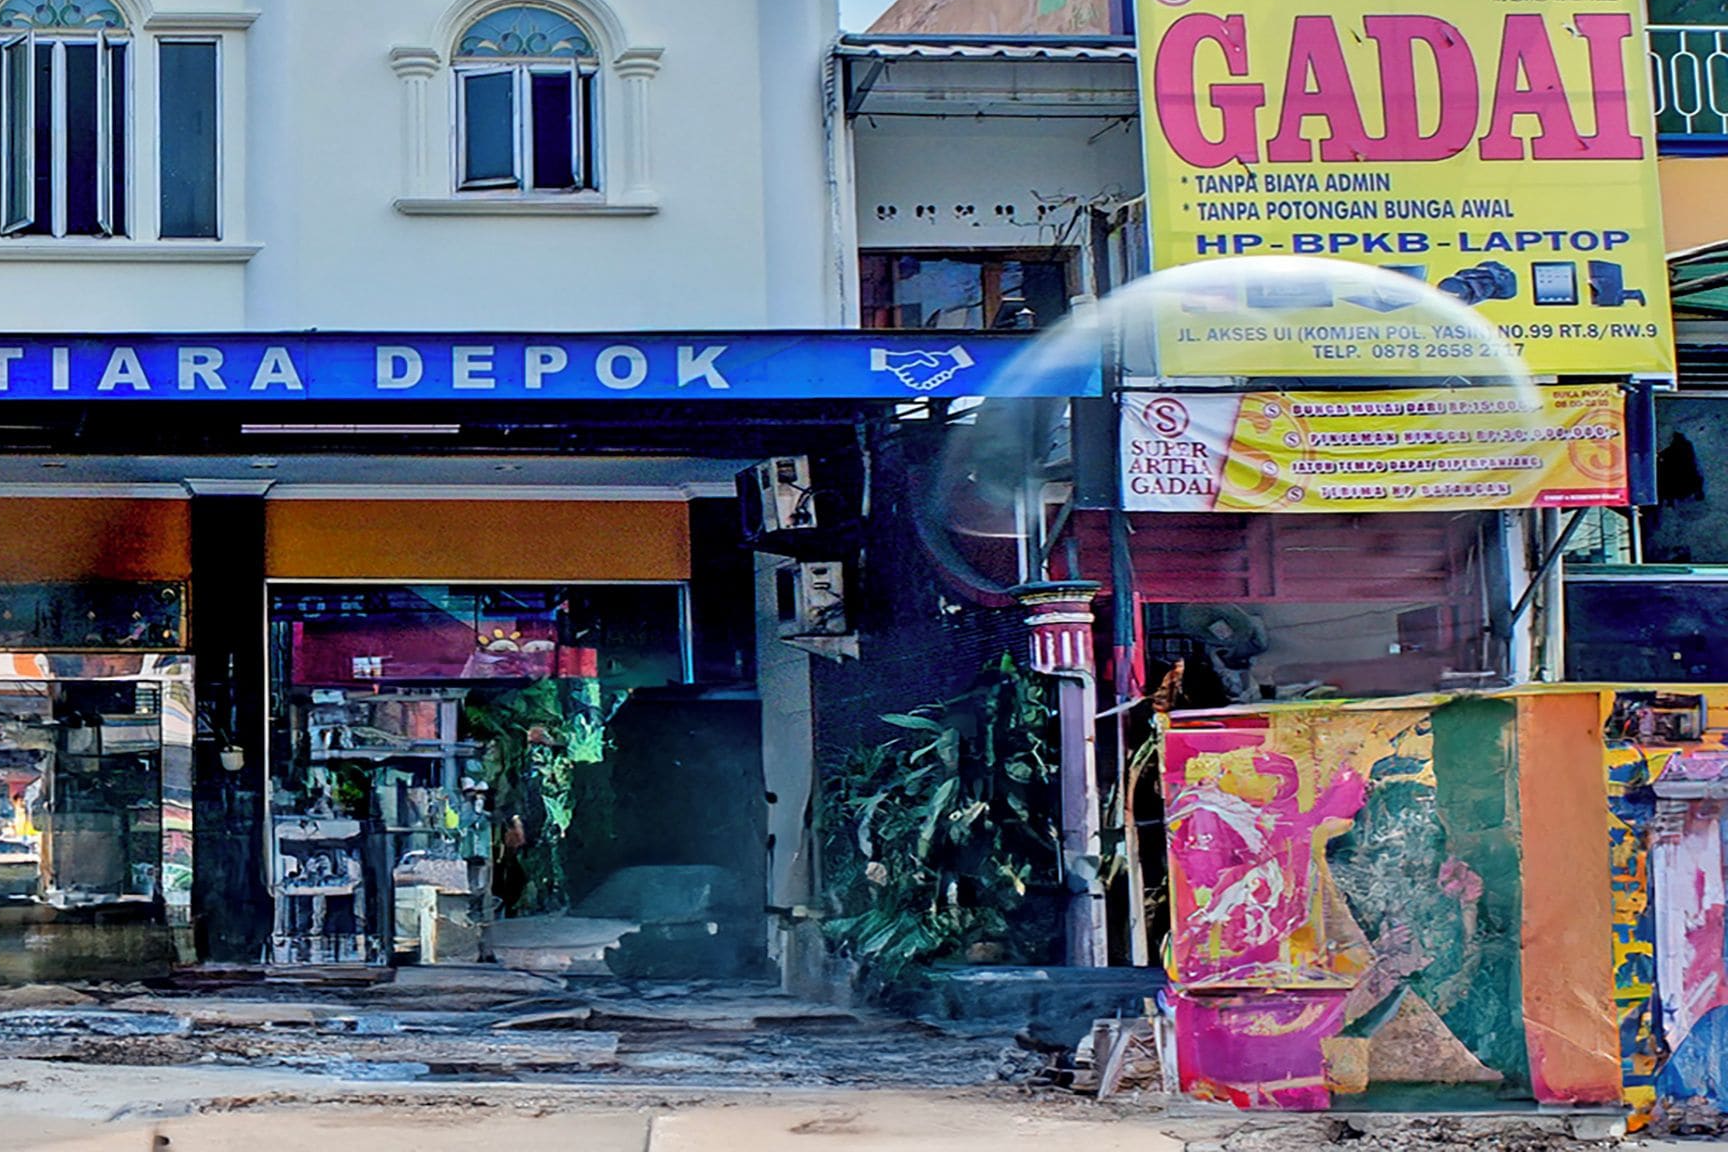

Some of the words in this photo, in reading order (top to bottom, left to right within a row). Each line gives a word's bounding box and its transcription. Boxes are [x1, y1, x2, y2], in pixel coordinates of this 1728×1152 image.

[1153, 13, 1645, 169] GADAI
[1195, 174, 1258, 194] TANPA
[1264, 173, 1319, 193] BIAYA
[1325, 172, 1391, 192] ADMIN
[1197, 201, 1260, 221] TANPA
[1267, 200, 1378, 221] POTONGAN
[1384, 199, 1456, 220] BUNGA
[1461, 198, 1515, 218] AWAL
[1177, 328, 1201, 342] JL.
[1206, 327, 1268, 342] AKSES
[1273, 327, 1293, 341] UI
[1297, 326, 1381, 343] (KOMJEN
[1386, 325, 1426, 341] POL.
[1431, 324, 1490, 340] YASI
[1498, 323, 1554, 339] NO.99
[1558, 323, 1659, 340] RT.8/RW.9
[1312, 344, 1361, 359] TELP.
[1371, 344, 1420, 359] 0878
[1425, 343, 1474, 358] 2658
[374, 344, 731, 391] DEPOK
[1130, 439, 1210, 459] SUPER
[1128, 457, 1213, 475] ARTHA
[1130, 476, 1217, 496] GADAI
